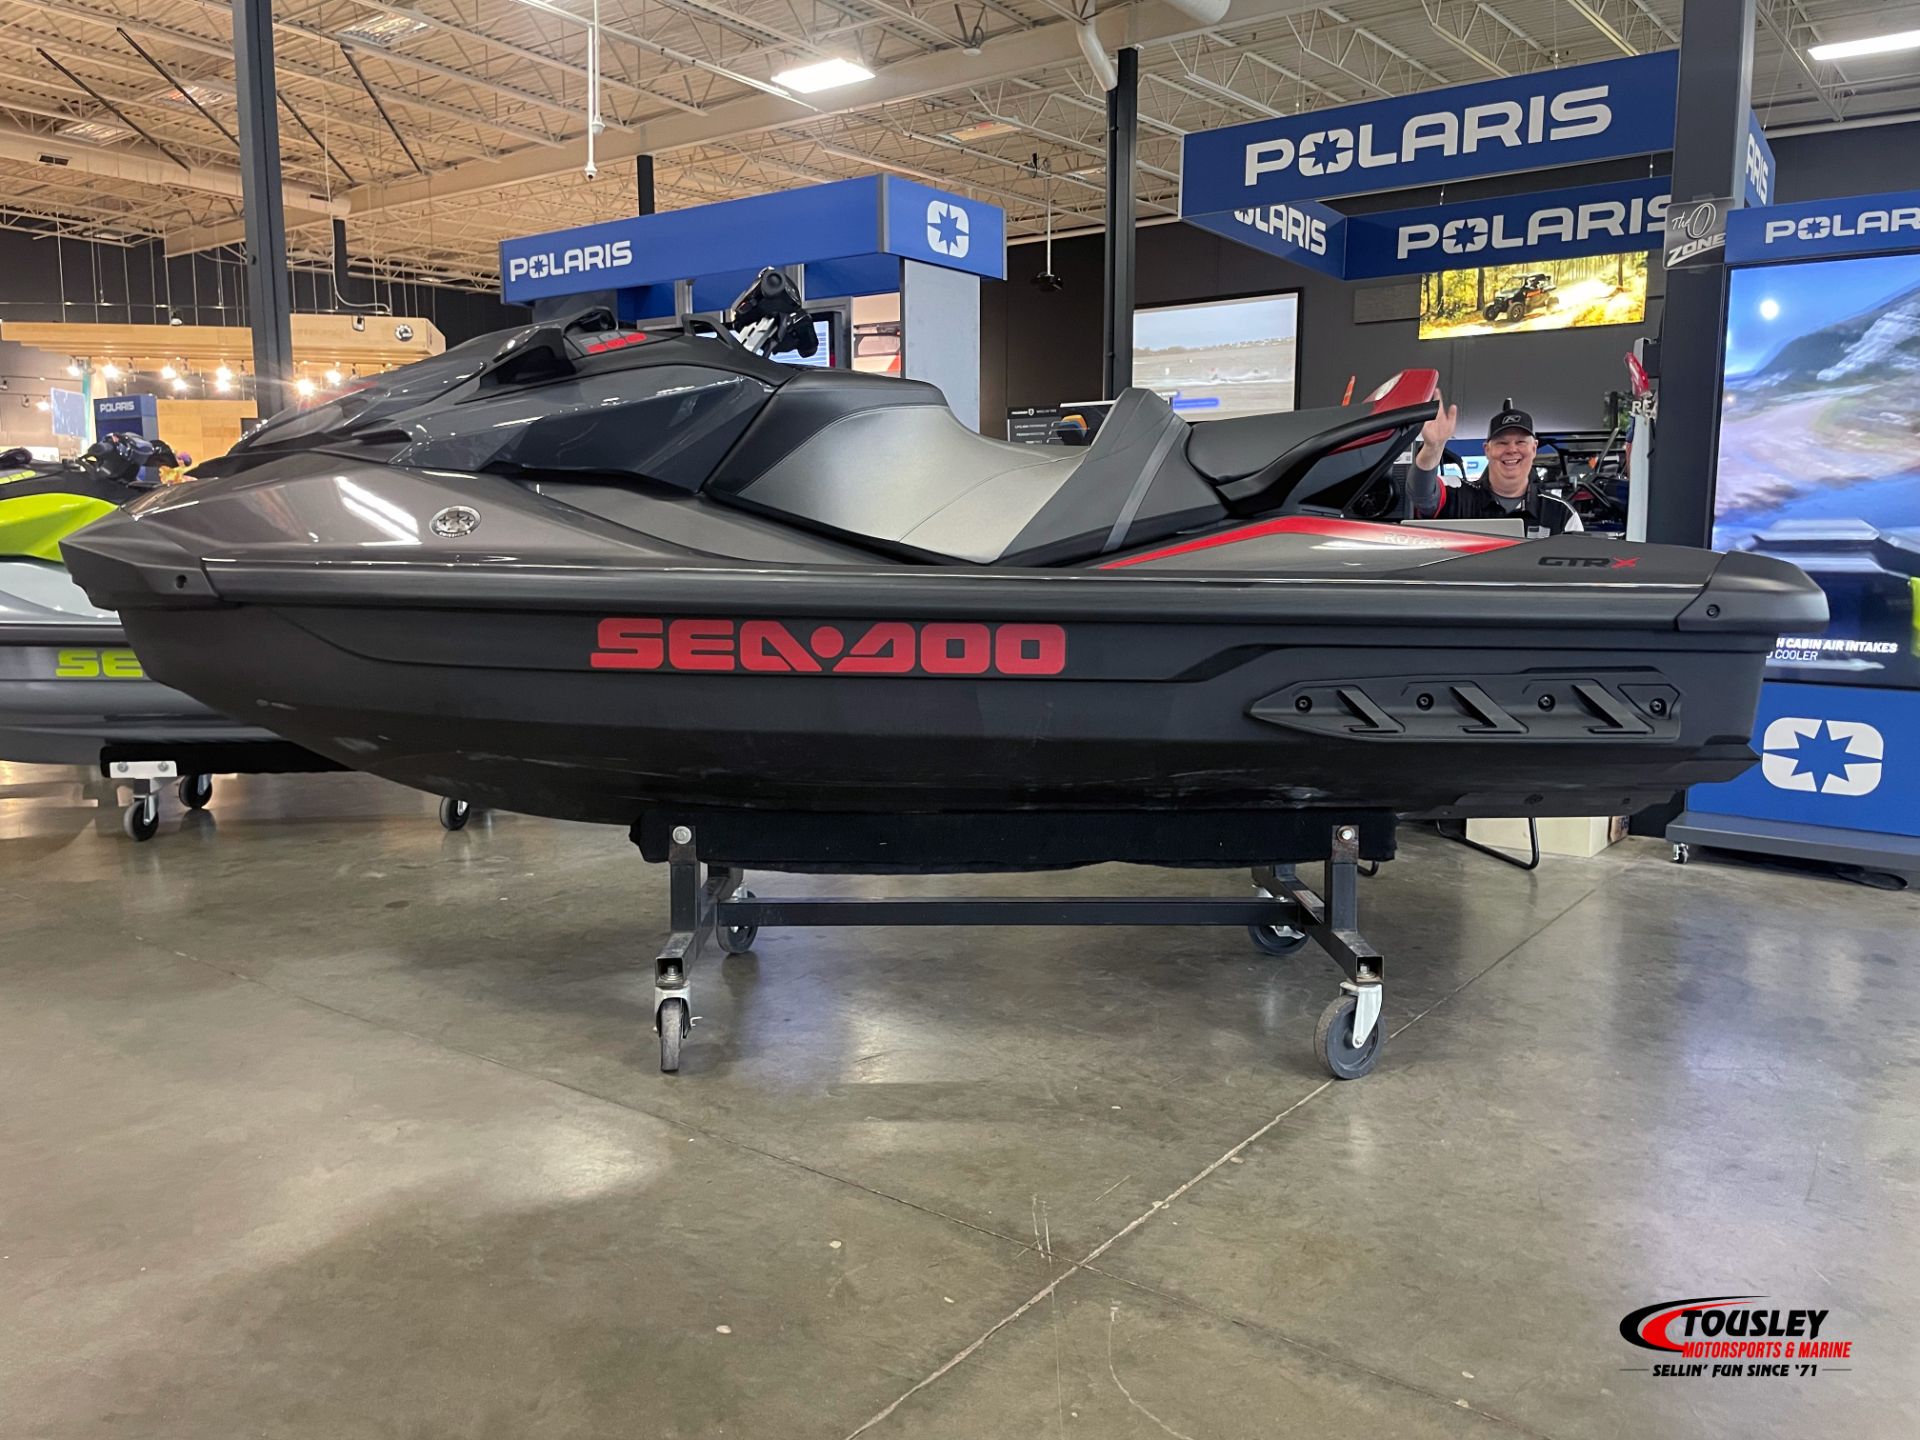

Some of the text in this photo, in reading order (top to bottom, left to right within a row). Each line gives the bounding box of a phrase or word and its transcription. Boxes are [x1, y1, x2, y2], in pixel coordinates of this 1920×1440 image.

[1244, 85, 1612, 186] POLARIS
[510, 240, 633, 282] POLARIS
[1667, 232, 1726, 268] ZONE
[100, 401, 135, 413] POLARIS
[1775, 649, 1818, 660] COOLER
[1786, 638, 1822, 650] CABIN
[1822, 639, 1845, 651] AIR
[1845, 640, 1898, 653] INTAKES
